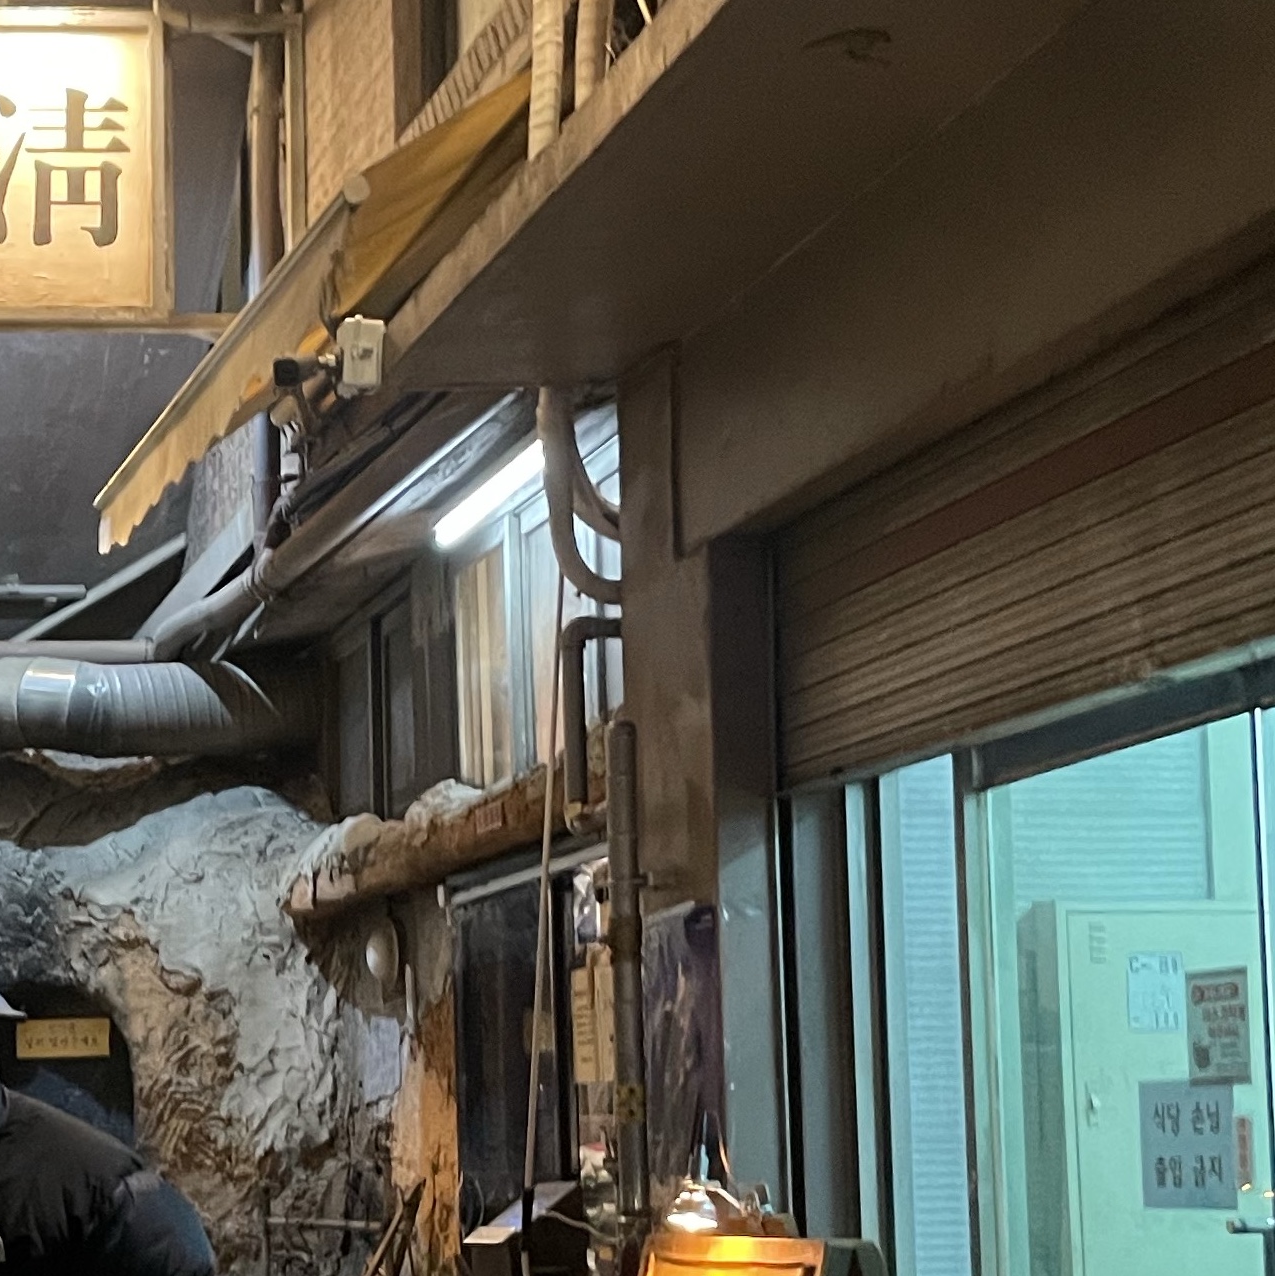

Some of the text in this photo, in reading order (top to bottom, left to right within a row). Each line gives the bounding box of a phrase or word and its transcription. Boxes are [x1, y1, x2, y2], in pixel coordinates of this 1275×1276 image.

[1153, 1101, 1220, 1137] 식당 손님
[1154, 1154, 1223, 1189] 출입 금지
